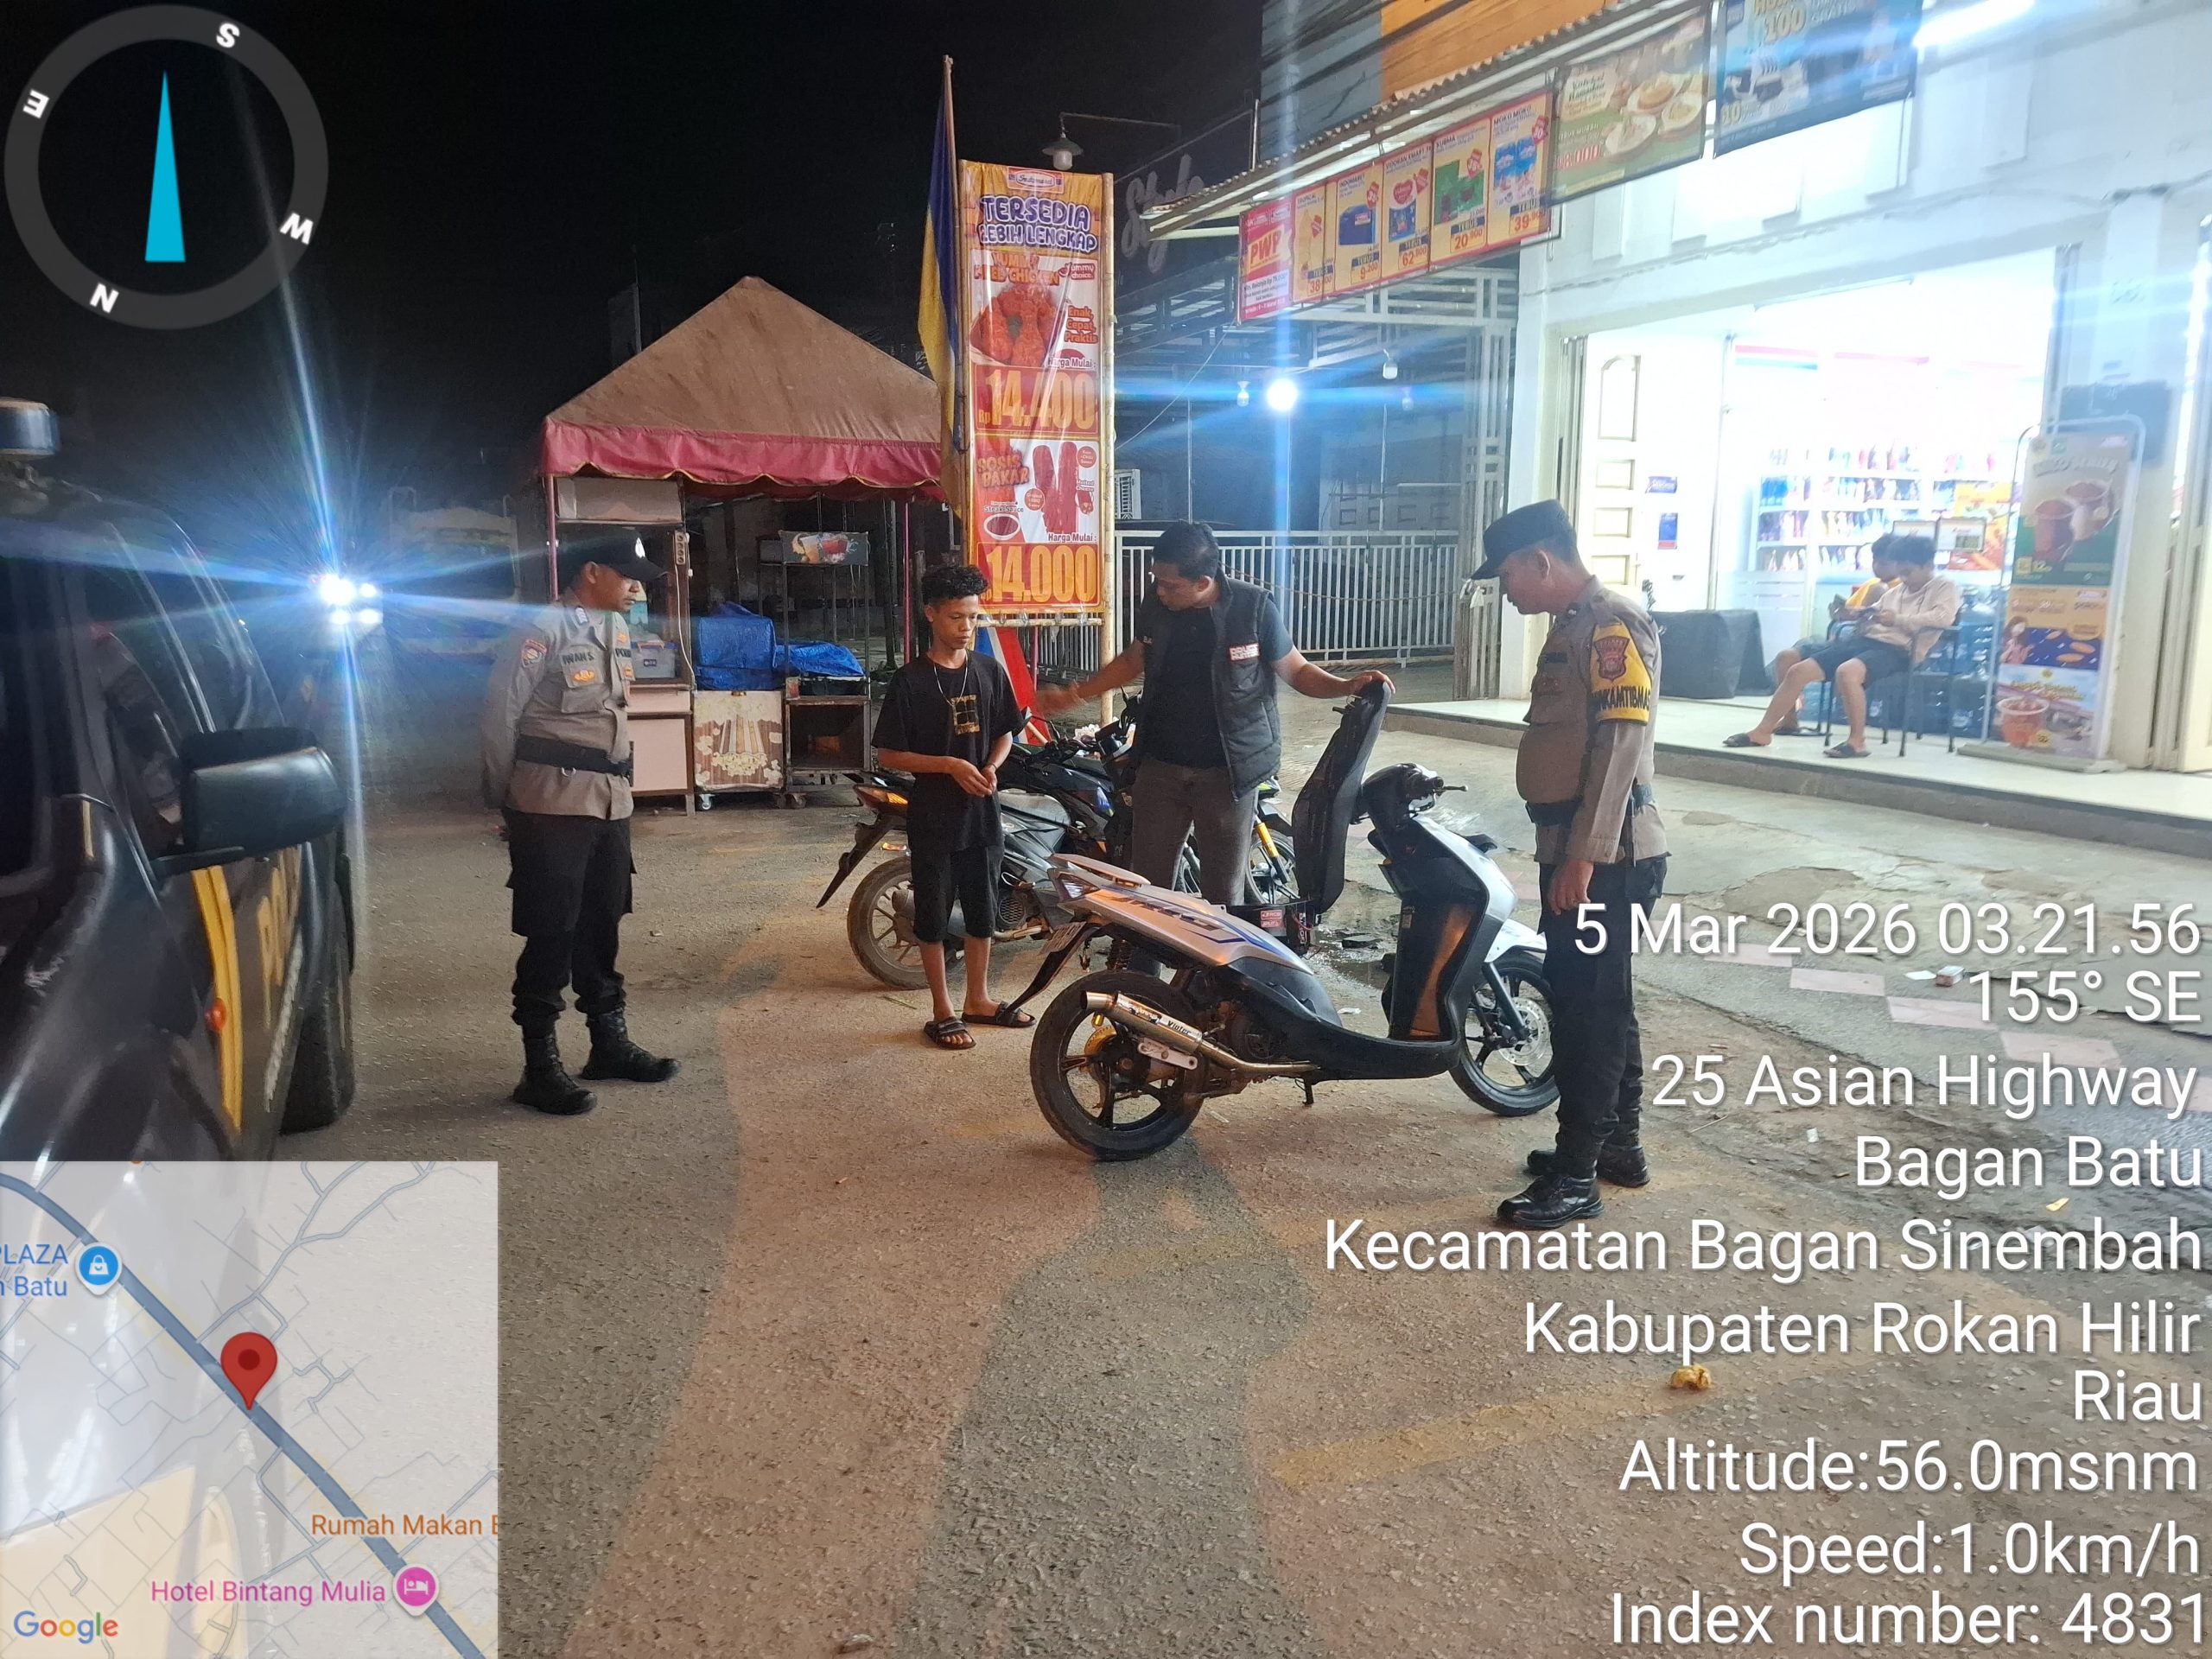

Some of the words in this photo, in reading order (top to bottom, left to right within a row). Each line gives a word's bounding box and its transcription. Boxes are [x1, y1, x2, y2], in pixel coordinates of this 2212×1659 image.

[982, 195, 1090, 232] TERSEDIA
[979, 224, 1024, 243] LEBIH
[1027, 225, 1098, 252] LENGKAP
[1249, 229, 1282, 264] PWP
[1065, 319, 1096, 334] Cepat,
[1064, 331, 1098, 344] Praktis
[976, 454, 1022, 474] SOSIS
[981, 467, 1030, 487] BAKAR
[1048, 532, 1071, 543] Harga
[1071, 532, 1093, 542] Mulai
[986, 544, 1096, 603] 14.000
